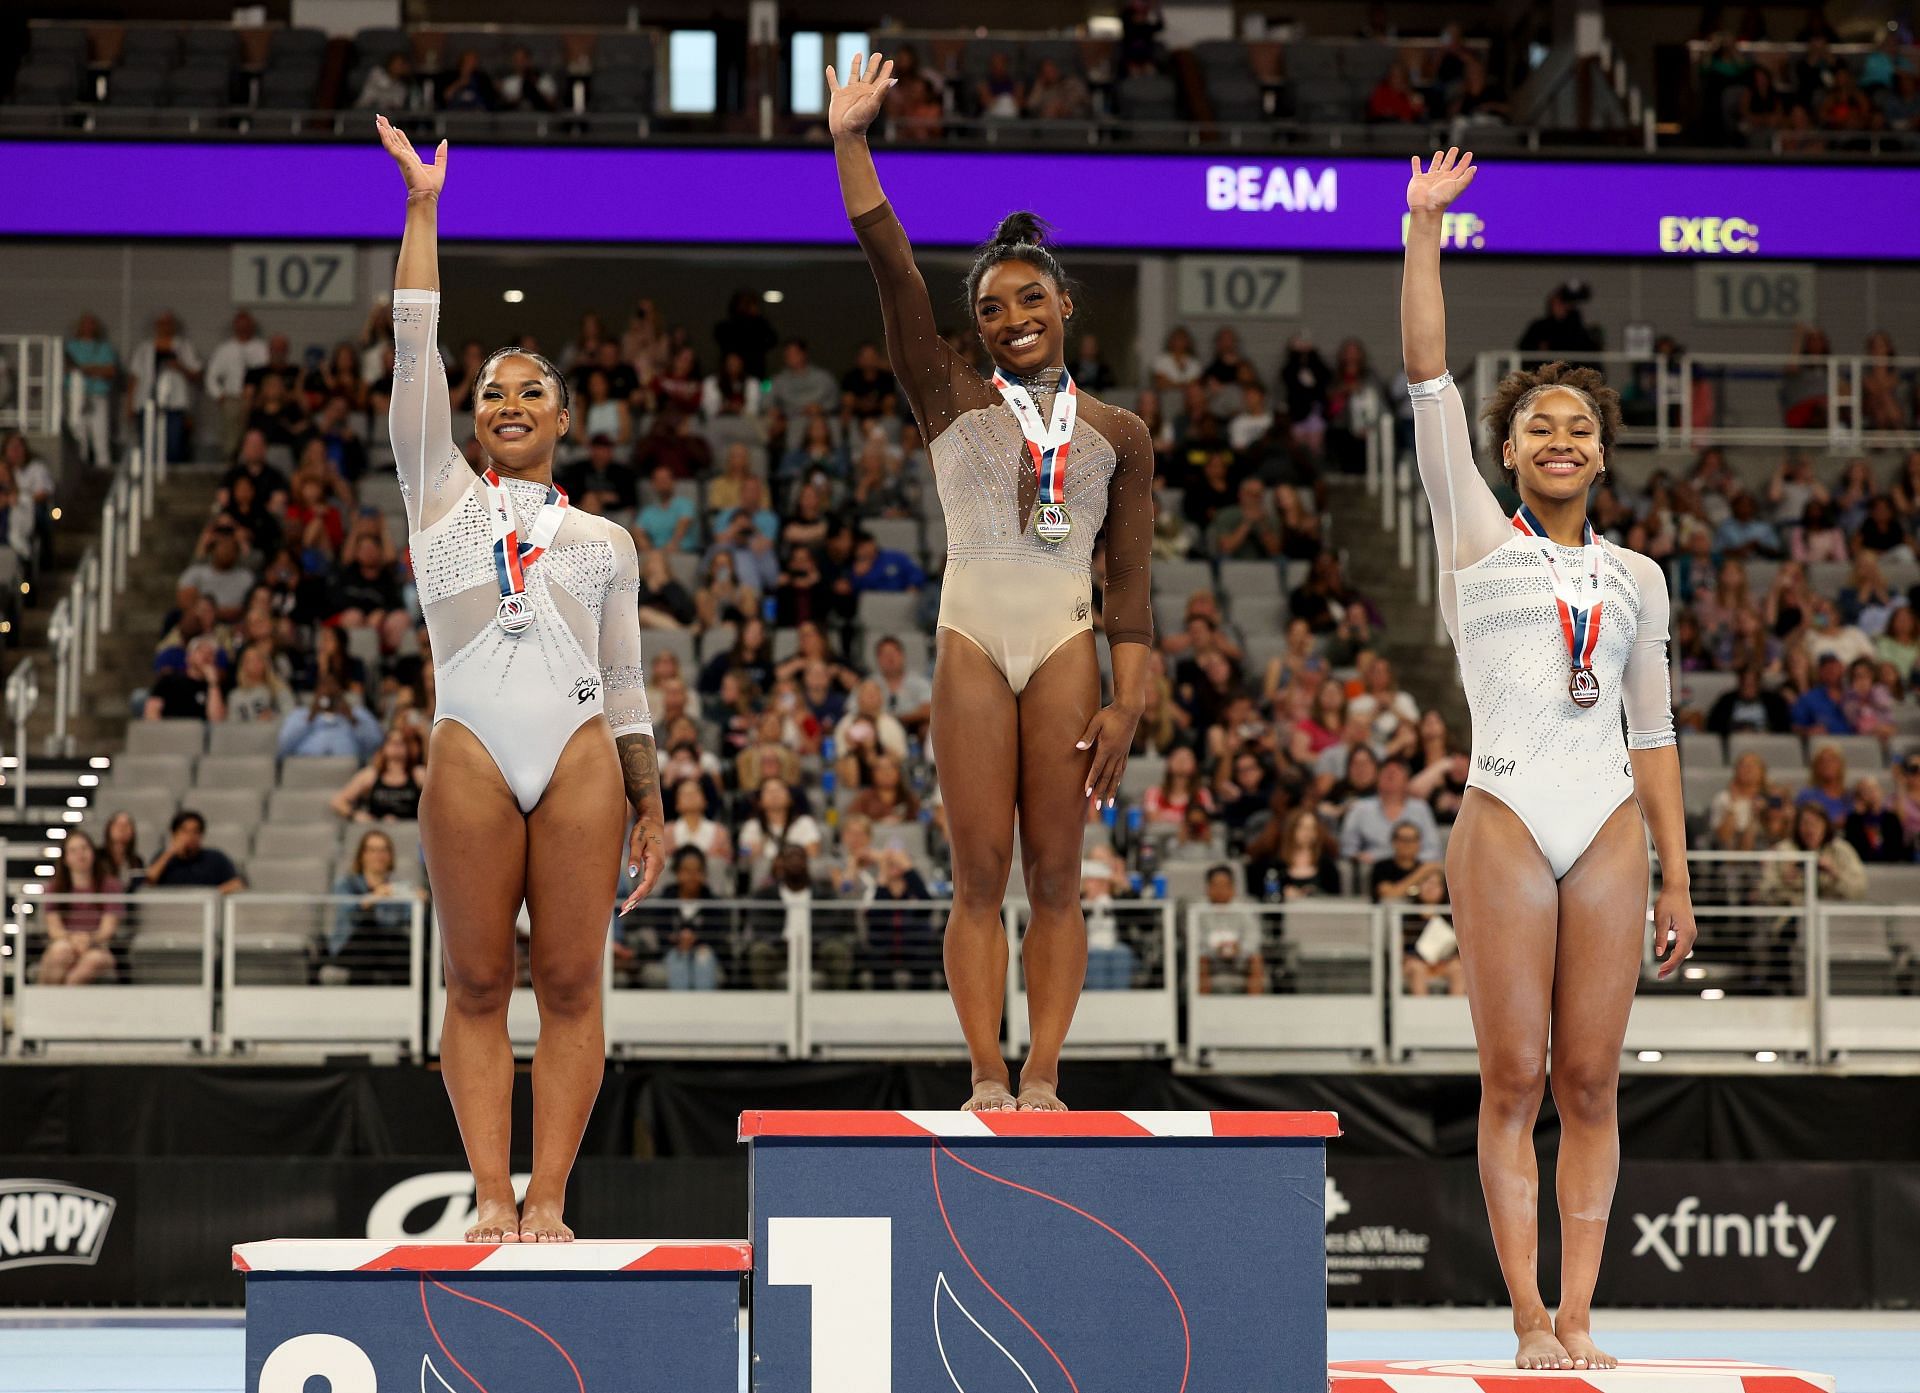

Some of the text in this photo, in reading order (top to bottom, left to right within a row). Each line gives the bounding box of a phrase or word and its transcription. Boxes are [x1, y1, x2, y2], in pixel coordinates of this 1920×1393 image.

[1206, 166, 1337, 212] BEAM
[1660, 216, 1759, 253] EXEC:
[250, 254, 341, 299] 107
[1200, 266, 1287, 310] 107
[1713, 271, 1799, 318] 108
[1477, 755, 1516, 777] WOGA
[0, 1193, 109, 1256] KIPPY
[1631, 1196, 1837, 1272] xfinity
[768, 1217, 892, 1393] 1
